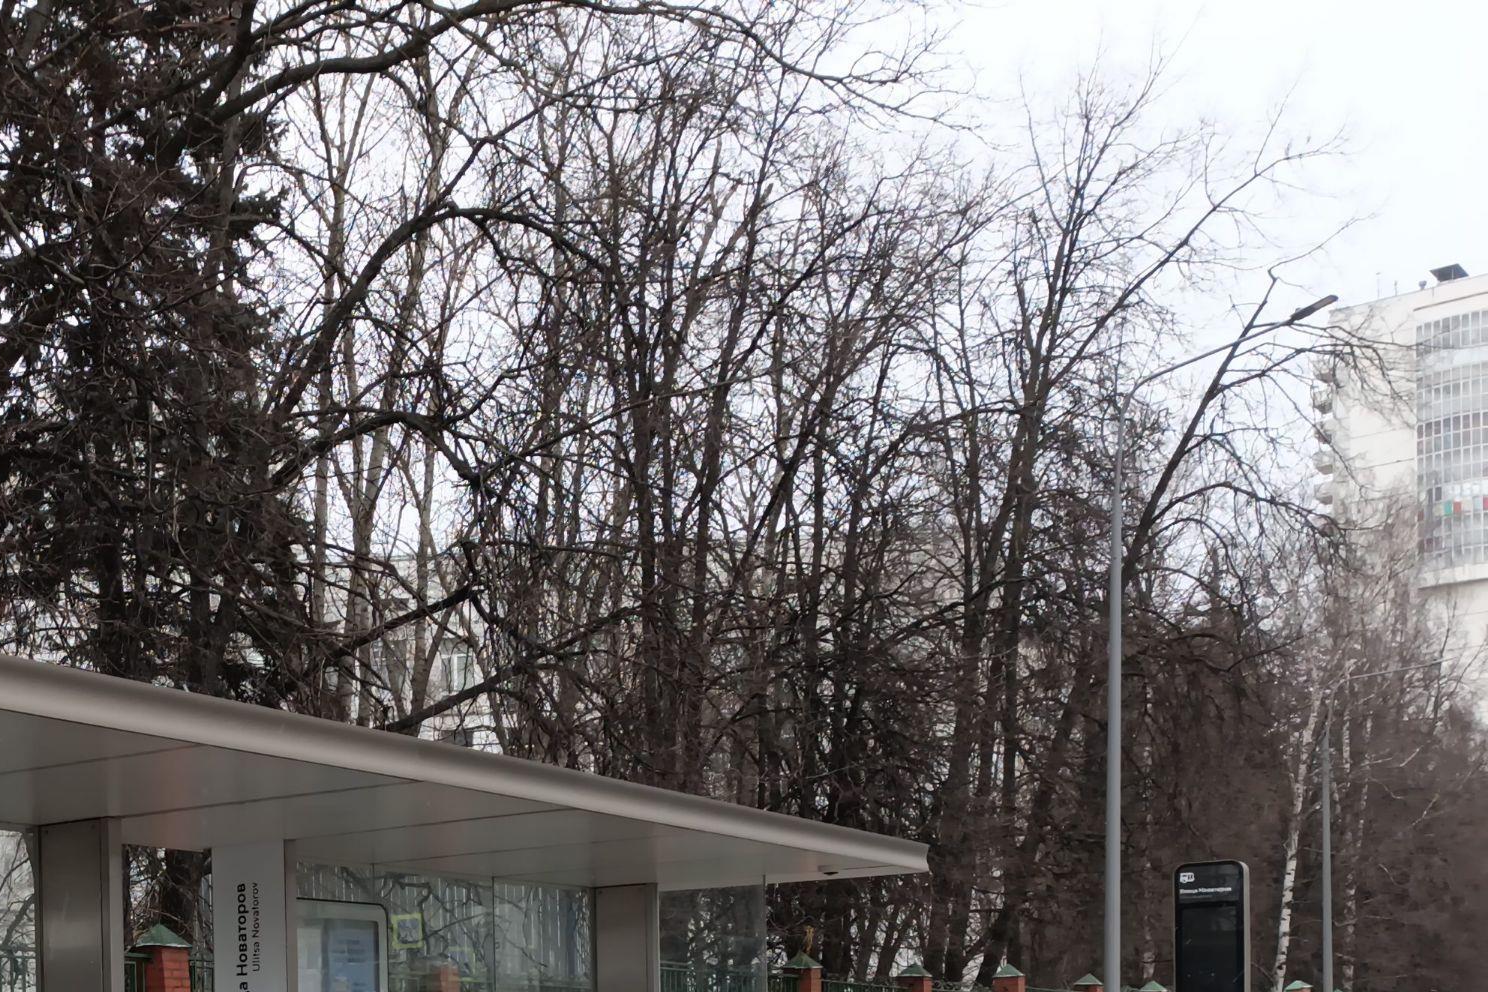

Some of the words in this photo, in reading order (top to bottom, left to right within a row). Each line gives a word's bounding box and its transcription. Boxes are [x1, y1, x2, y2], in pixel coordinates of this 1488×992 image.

[236, 883, 249, 977] Новаторов
[251, 882, 260, 938] Novatorov
[252, 941, 260, 972] Ulitsa
